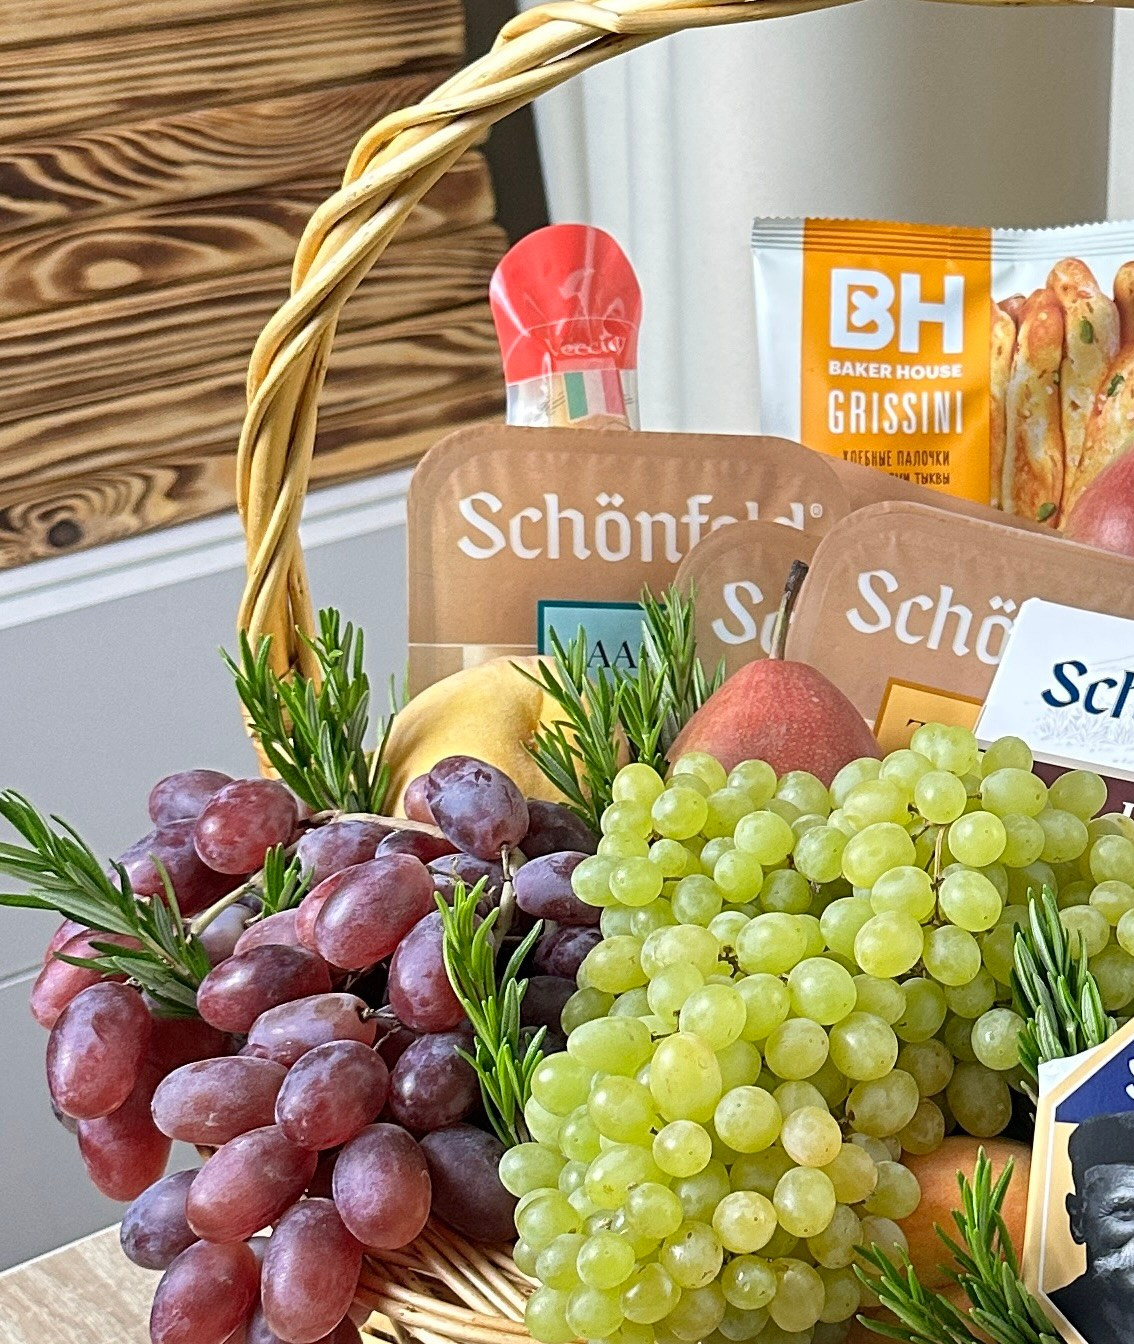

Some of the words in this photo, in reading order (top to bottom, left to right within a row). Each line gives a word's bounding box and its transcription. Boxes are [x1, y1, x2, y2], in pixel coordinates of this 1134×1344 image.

[830, 268, 965, 354] BH
[828, 360, 892, 379] BAKER
[896, 364, 963, 380] HOUSE
[828, 389, 963, 435] GRISSINI
[897, 450, 950, 467] ПАЛОЧКИ
